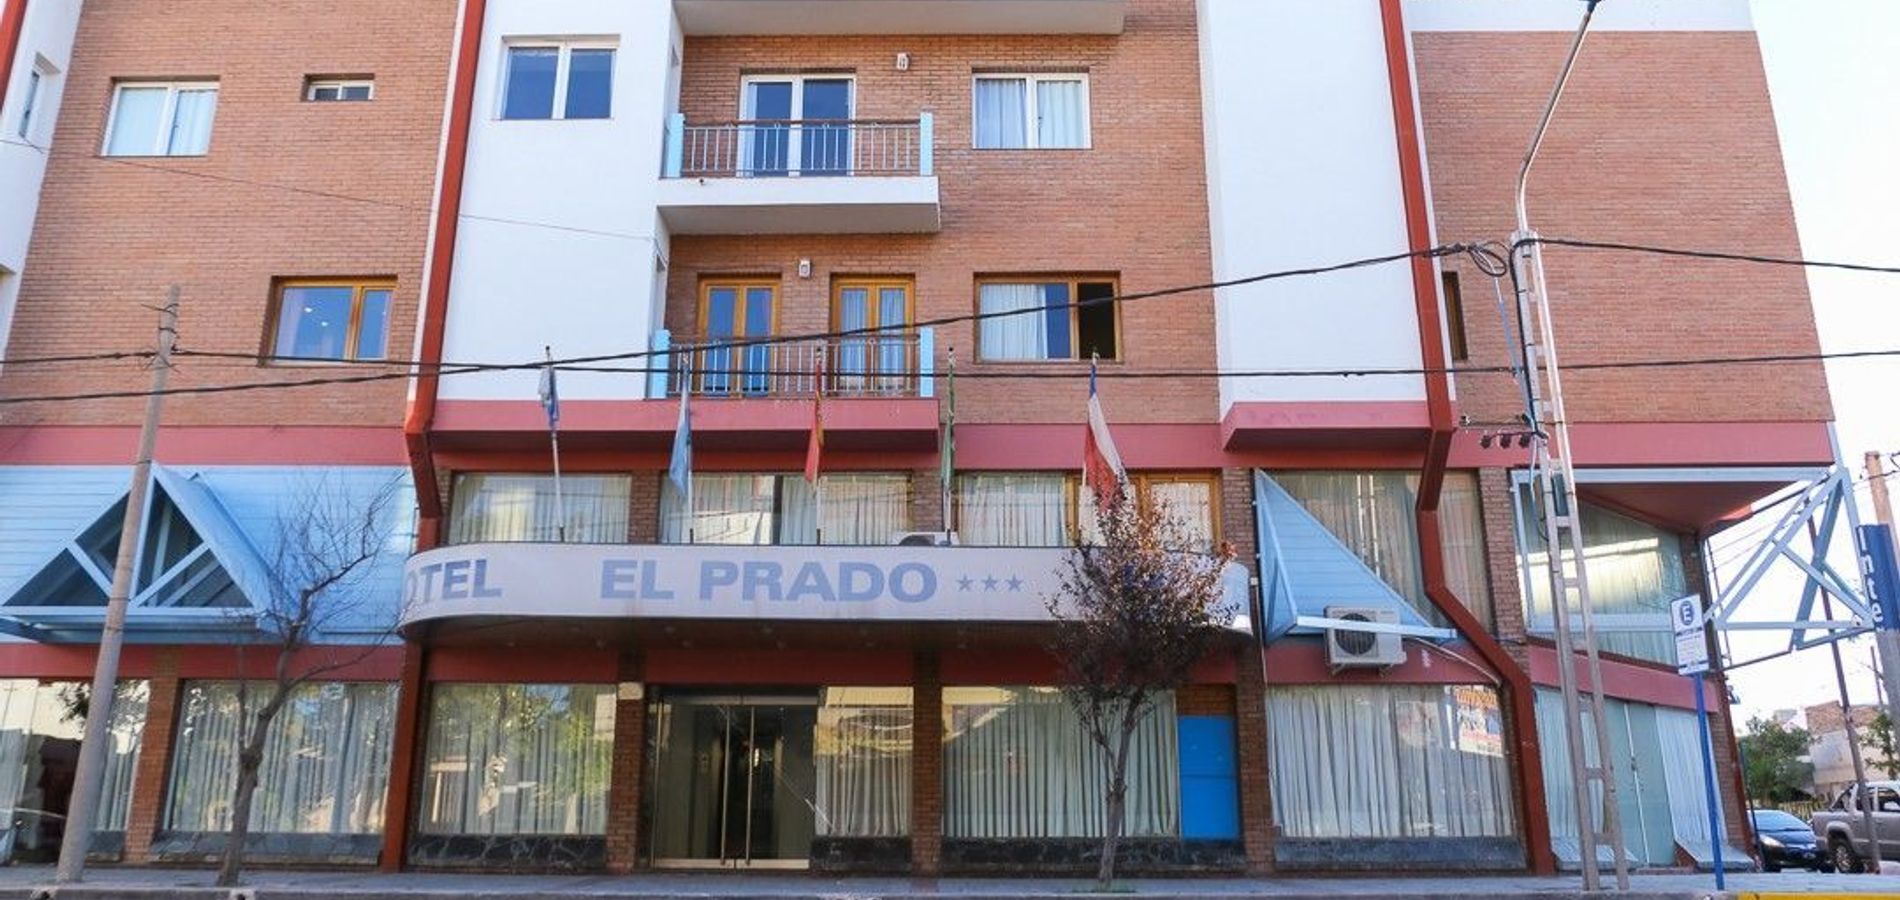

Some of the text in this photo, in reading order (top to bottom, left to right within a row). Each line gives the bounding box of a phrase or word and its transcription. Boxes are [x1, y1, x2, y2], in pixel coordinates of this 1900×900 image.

[402, 559, 938, 606] OTEL EL PRADO
